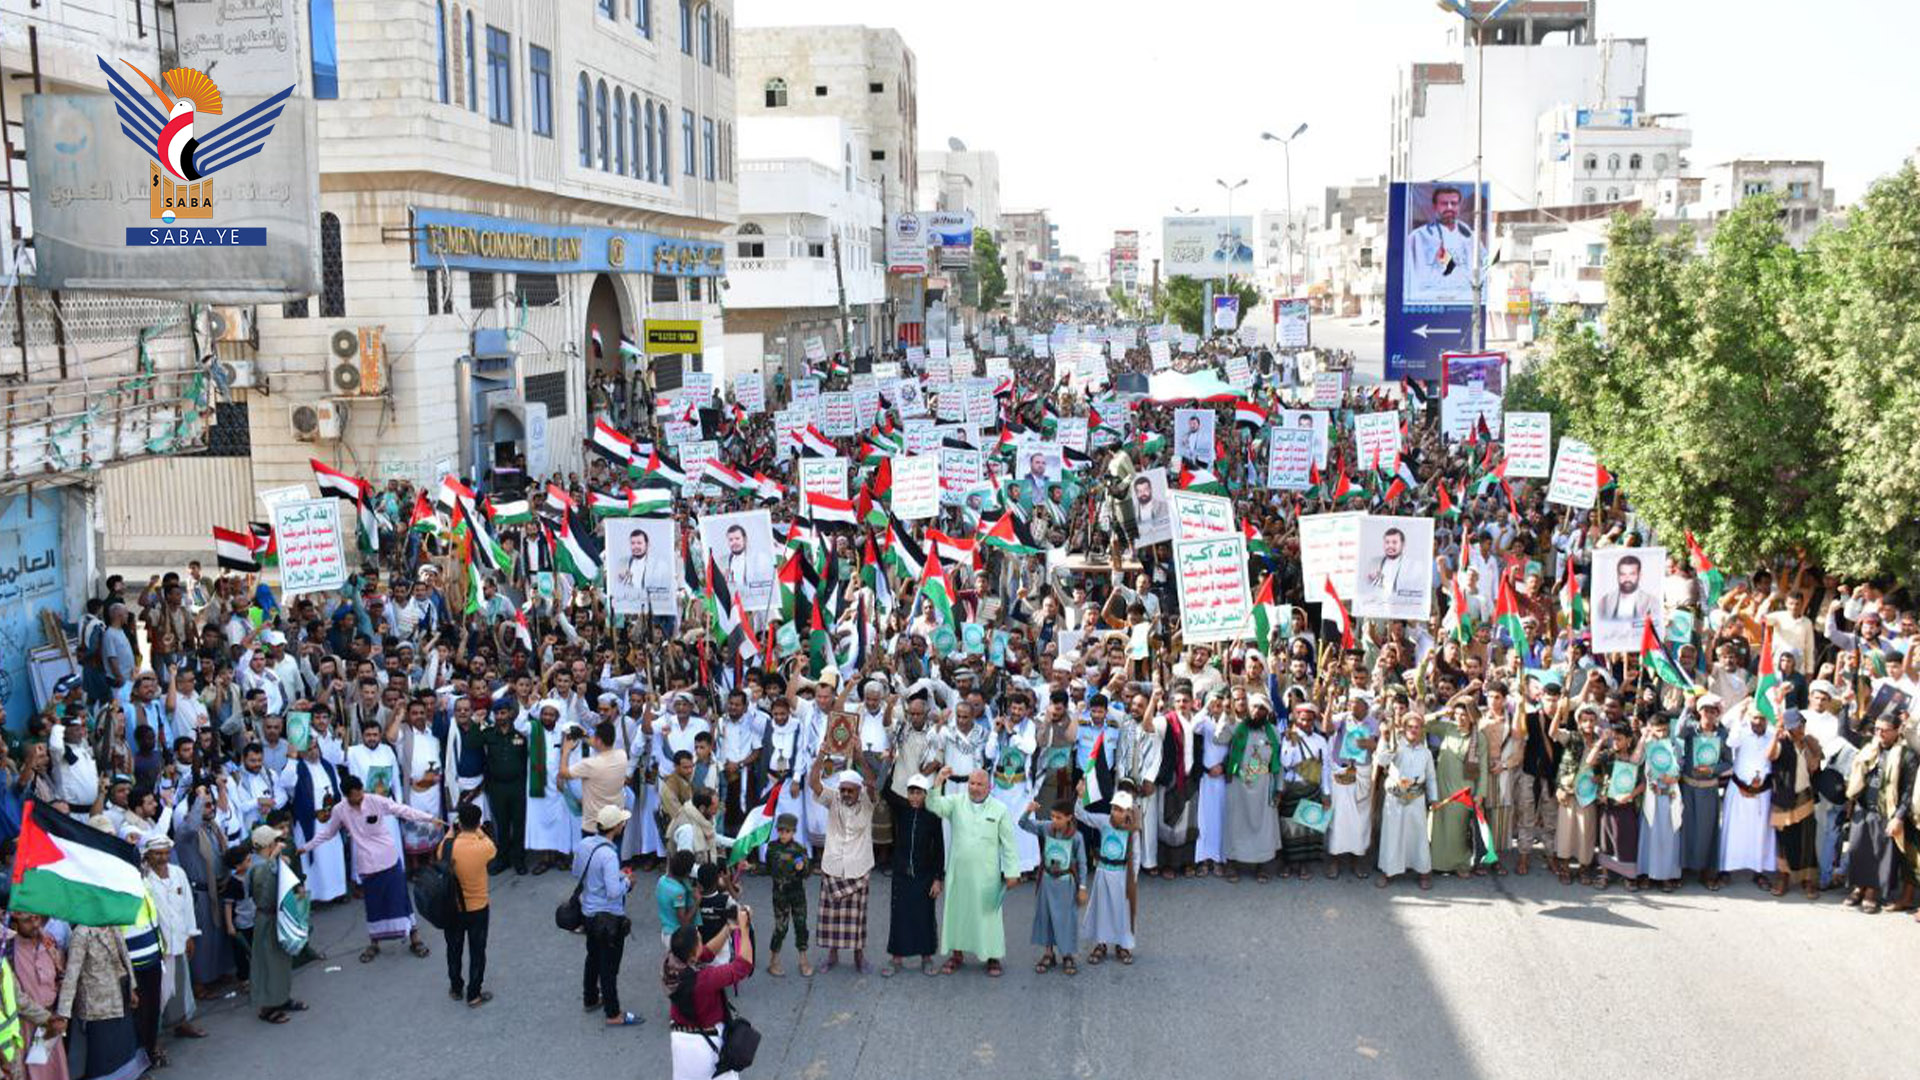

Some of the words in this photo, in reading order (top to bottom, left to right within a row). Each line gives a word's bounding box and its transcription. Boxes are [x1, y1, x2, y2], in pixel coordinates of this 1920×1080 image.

[429, 224, 477, 254] YEMEN
[480, 230, 554, 261] COMMERCIAL
[556, 237, 582, 261] BANK
[282, 506, 311, 525] أكبر
[314, 507, 333, 519] الله
[1183, 544, 1214, 565] أكبر
[1217, 544, 1239, 557] الله
